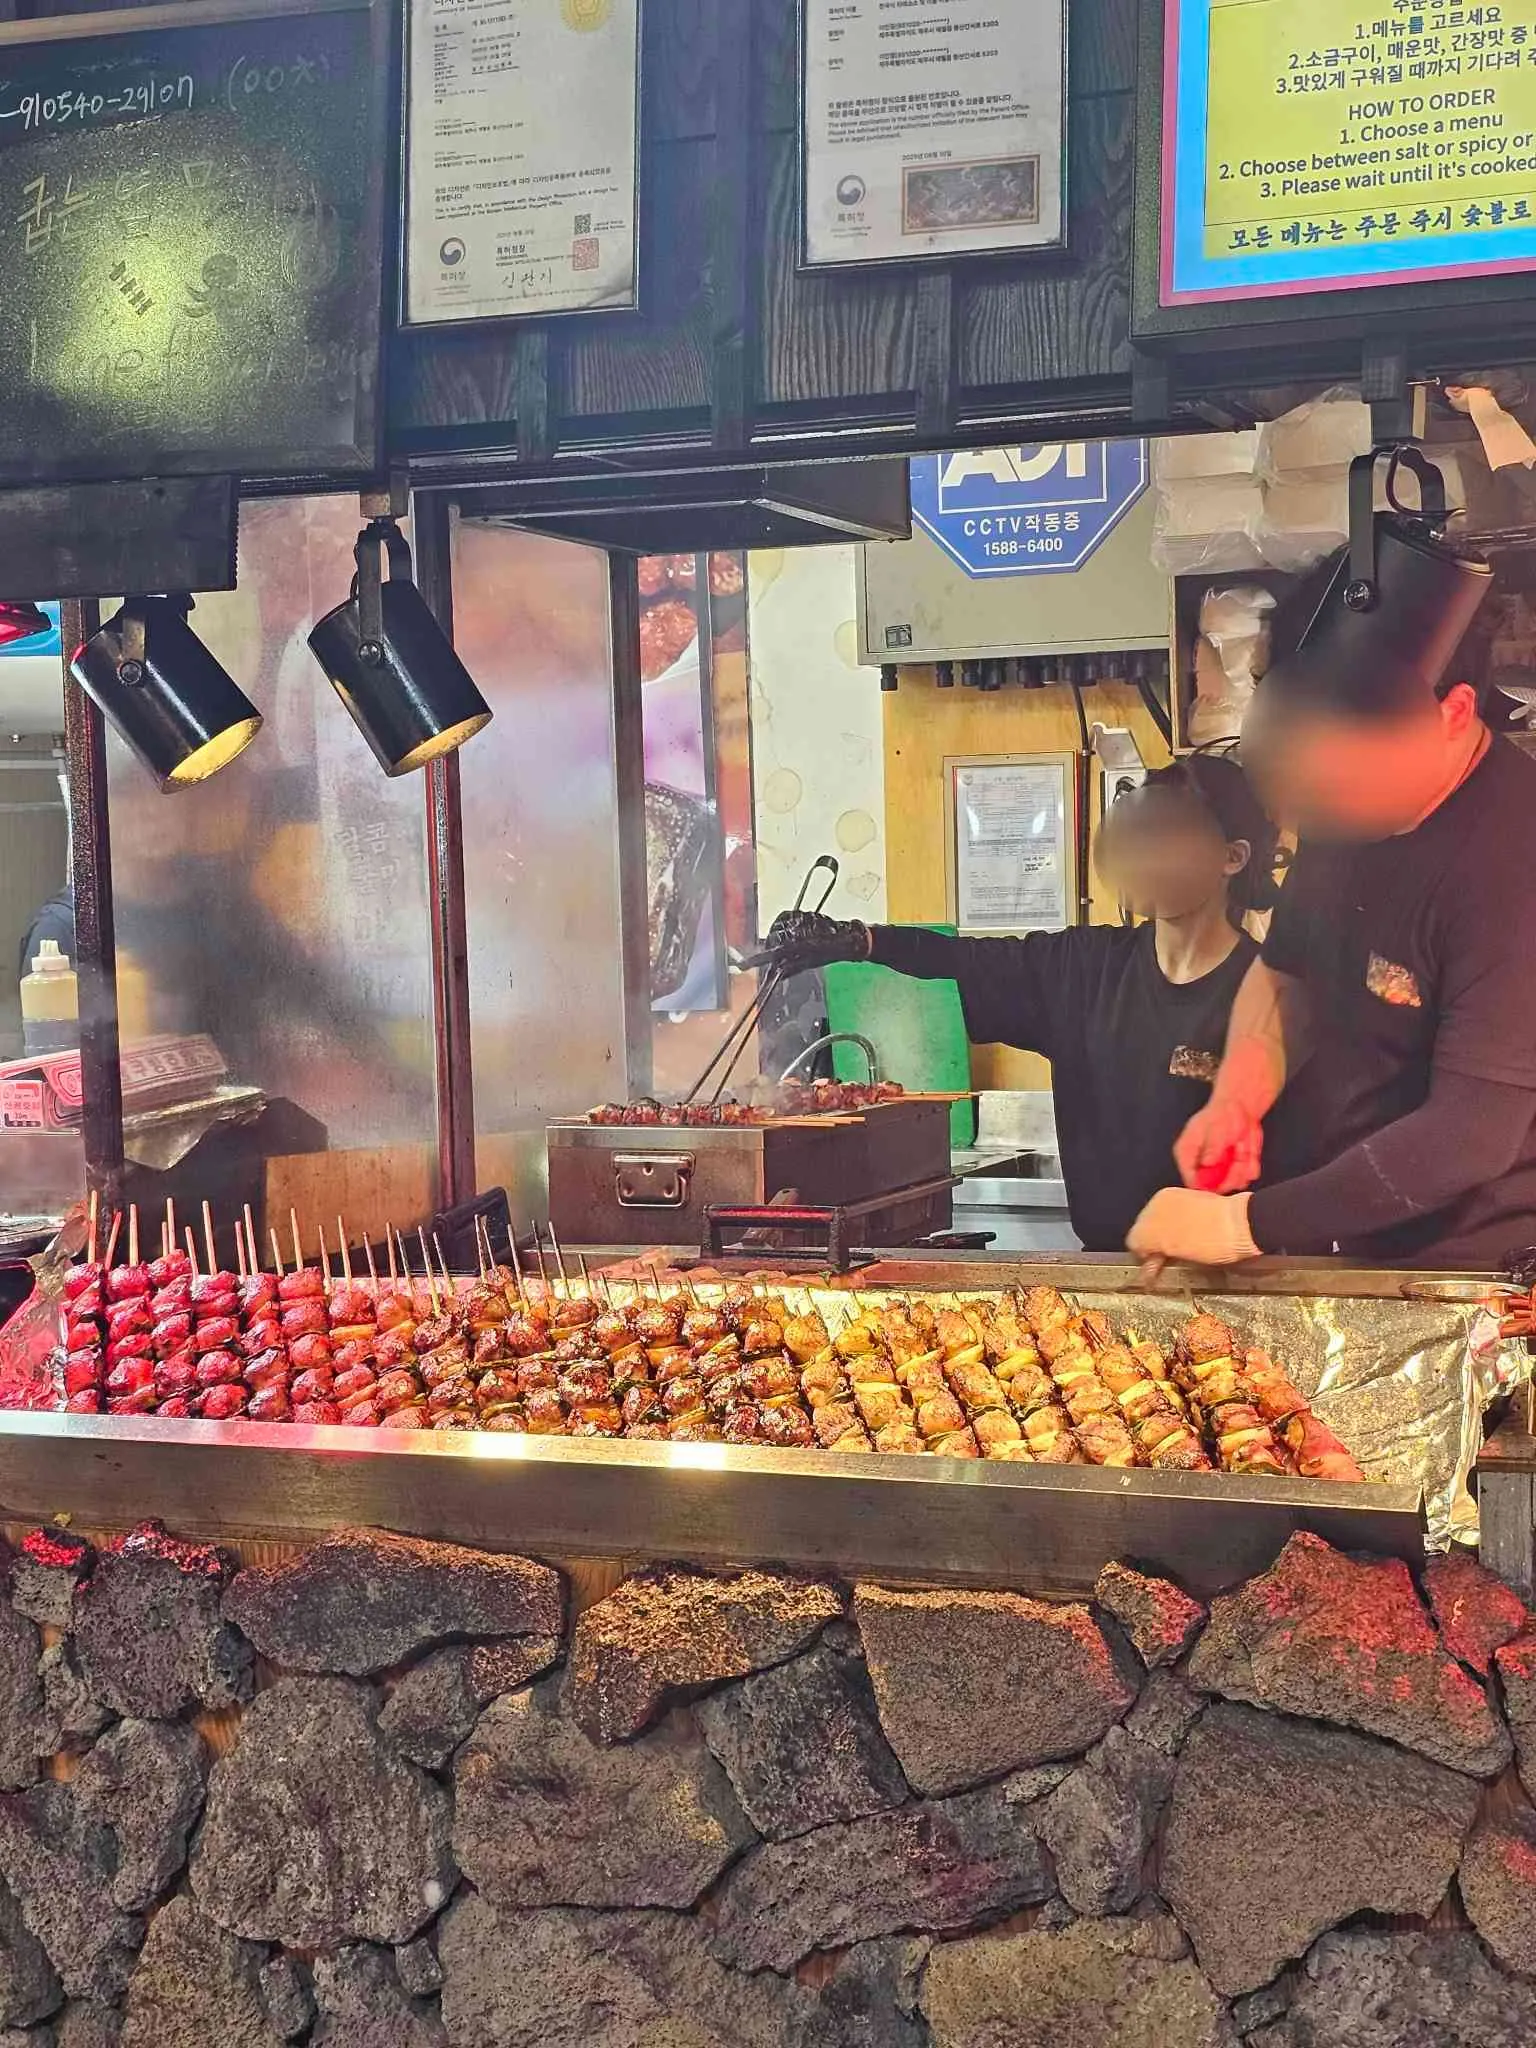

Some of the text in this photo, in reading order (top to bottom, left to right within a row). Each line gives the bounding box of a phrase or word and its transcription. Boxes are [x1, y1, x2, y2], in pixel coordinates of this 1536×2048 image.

[1355, 7, 1502, 39] 1.메뉴를 고르세요
[1289, 25, 1528, 69] 2.소금구이, 매운맛, 간장맛 중
[1276, 70, 1345, 94] 3.맛있게
[1351, 64, 1403, 87] 구워질
[1409, 57, 1461, 80] 때까지
[1467, 49, 1520, 71] 기다려
[1349, 88, 1496, 121] HOW TO ORDER
[1340, 113, 1504, 145] 1. Choose a menu
[1219, 133, 1534, 180] 2. Choose between salt or spicy or
[1260, 183, 1276, 199] 3.
[1282, 174, 1341, 196] Please
[1345, 171, 1385, 189] wait
[1390, 164, 1433, 184] until
[1438, 161, 1466, 181] it's
[1228, 199, 1532, 250] 모든 메뉴는 주문 즉시 숯불로
[984, 538, 1063, 556] 1588-6400
